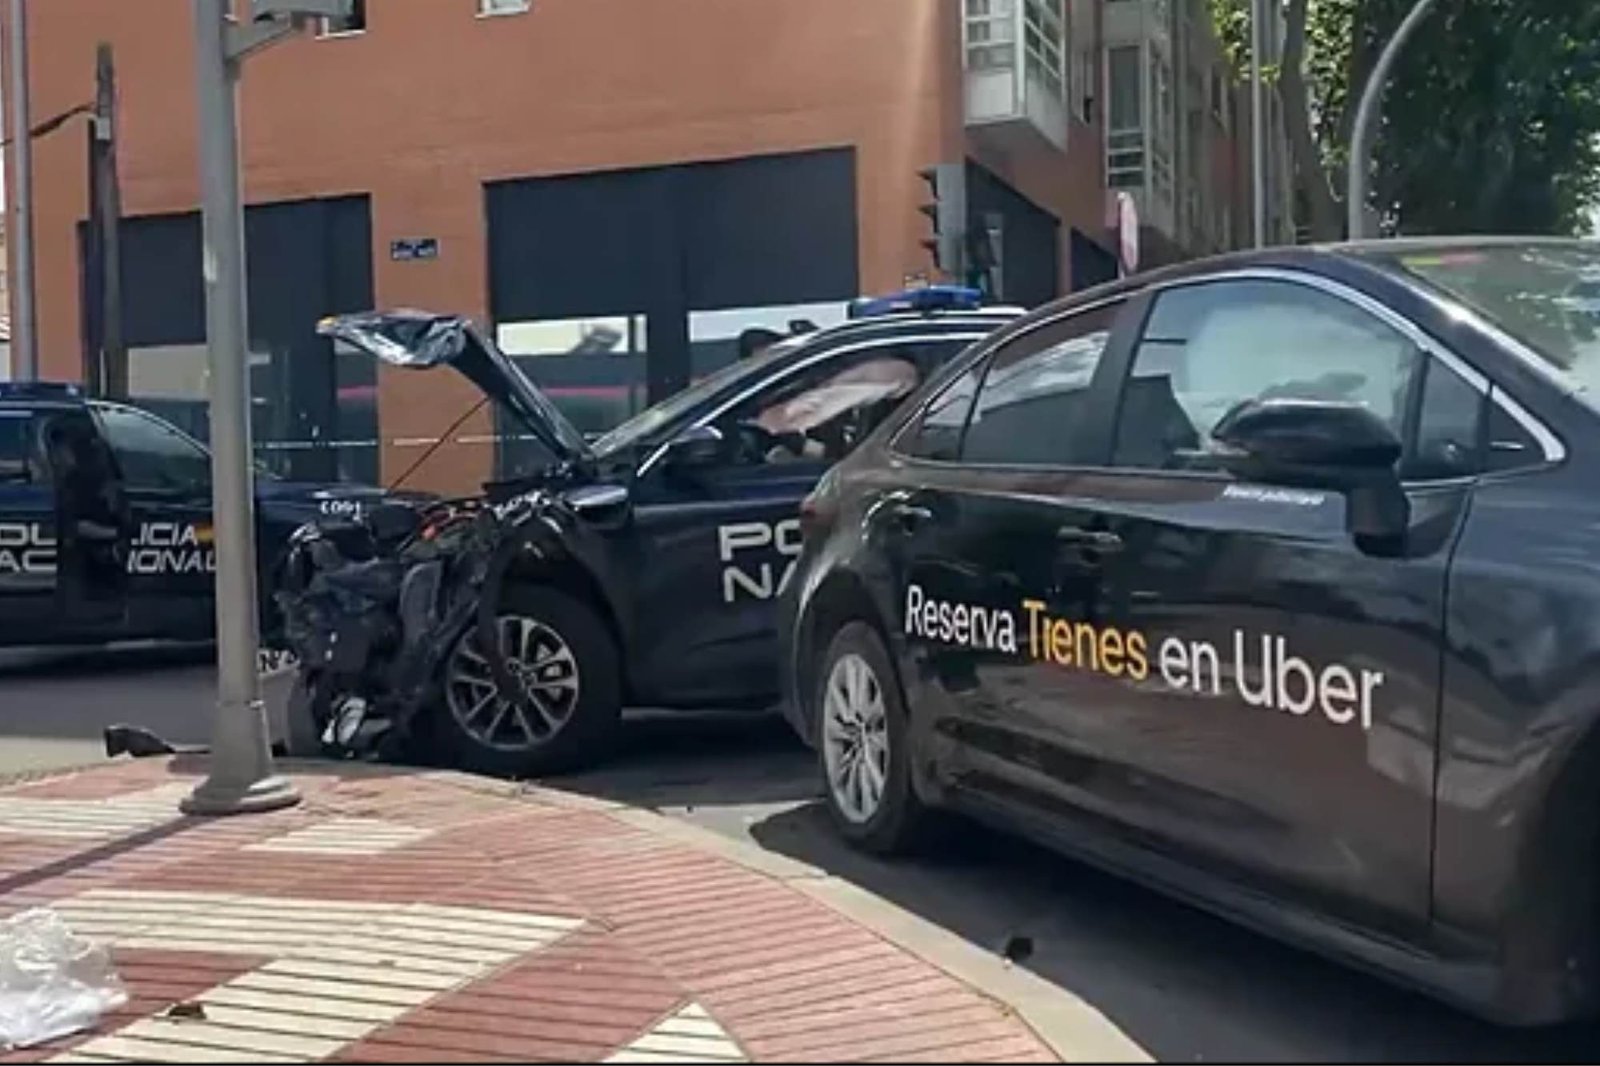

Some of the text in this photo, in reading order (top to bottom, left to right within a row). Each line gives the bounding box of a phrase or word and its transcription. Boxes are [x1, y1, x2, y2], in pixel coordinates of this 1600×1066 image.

[131, 522, 198, 546] ICIA
[904, 584, 1384, 730] Reserva Tienes en Uber
